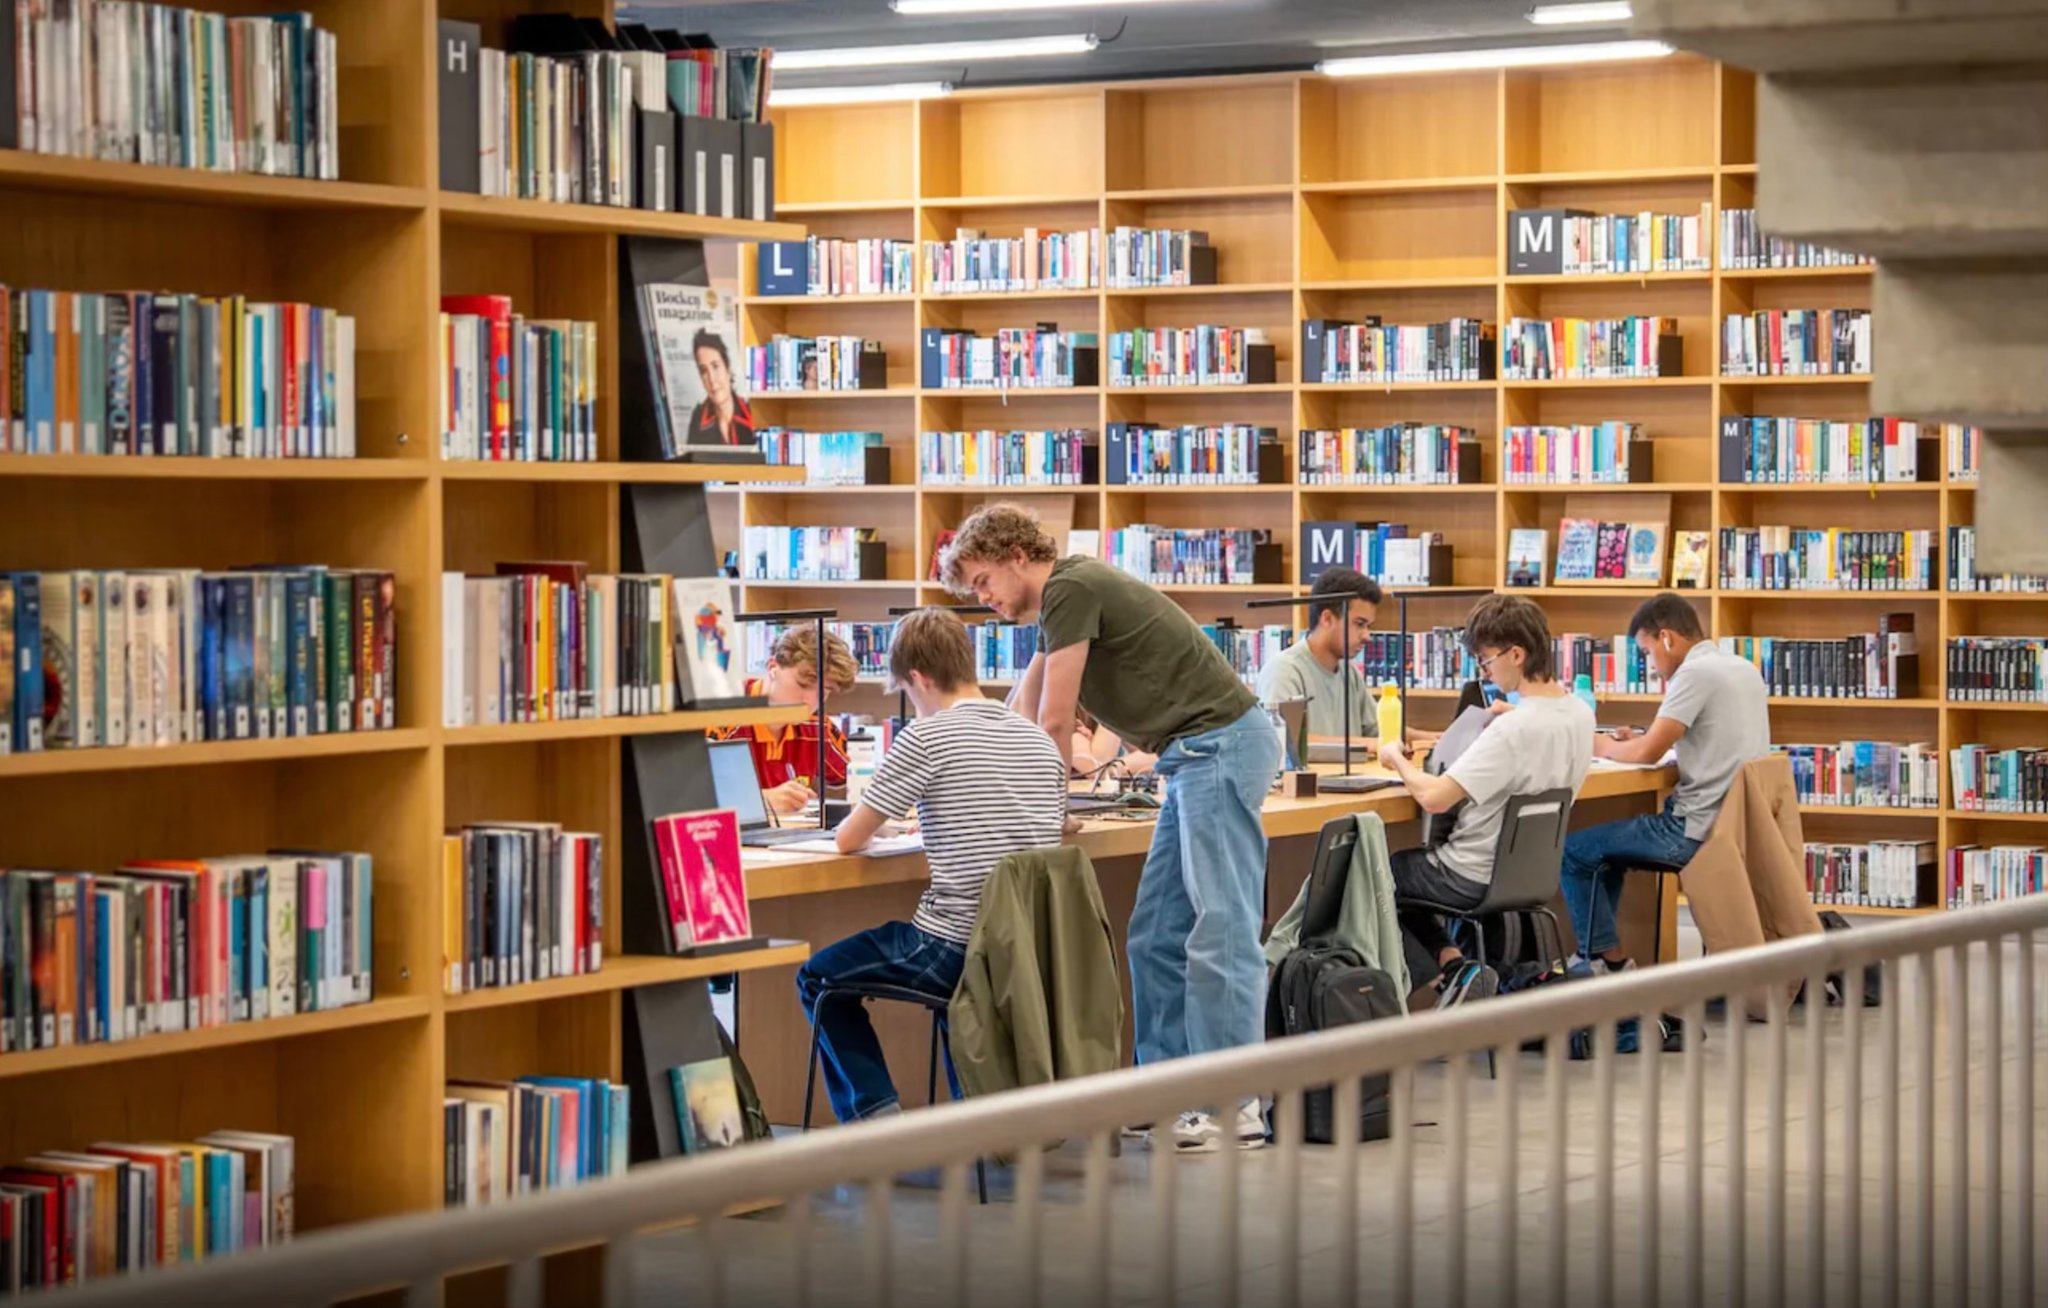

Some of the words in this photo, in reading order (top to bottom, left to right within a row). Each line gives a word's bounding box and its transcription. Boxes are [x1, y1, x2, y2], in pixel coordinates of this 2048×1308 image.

[447, 39, 468, 73] H
[1519, 216, 1553, 253] M
[773, 242, 793, 276] L
[657, 307, 714, 321] magazine
[1308, 325, 1317, 340] L
[927, 333, 936, 348] L
[1111, 428, 1121, 442] L
[1724, 422, 1738, 437] M
[1311, 528, 1344, 564] M
